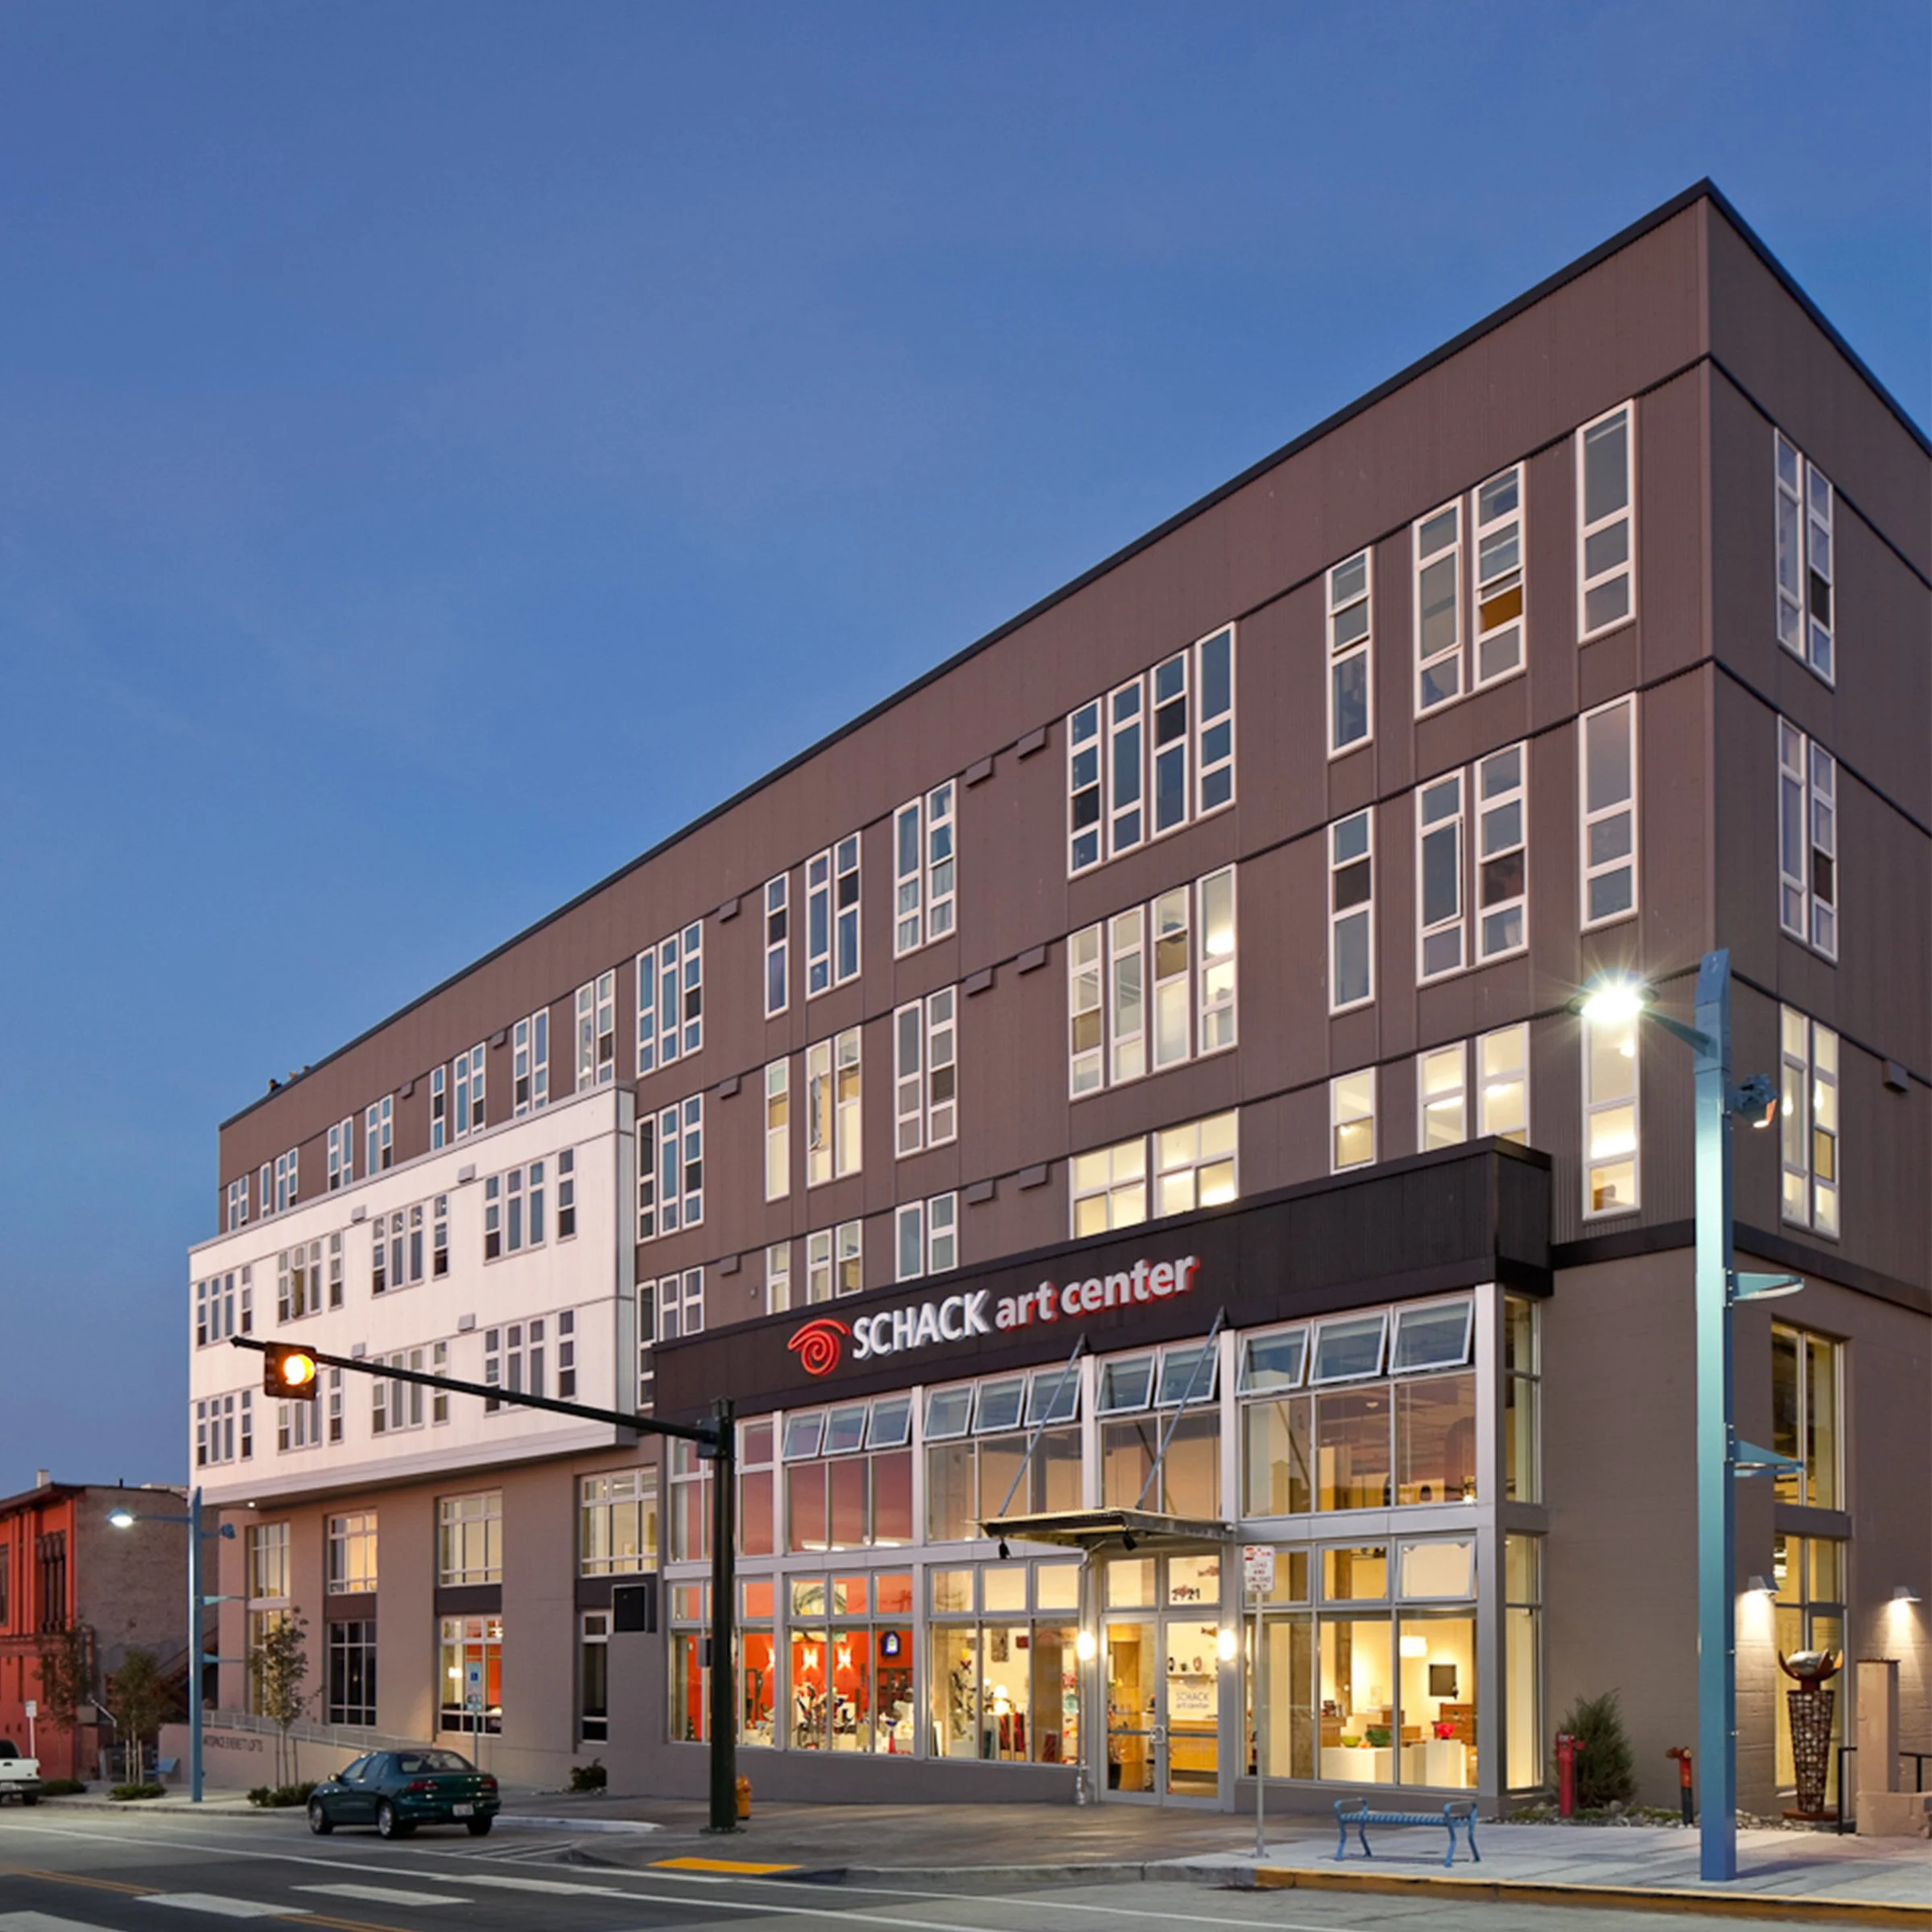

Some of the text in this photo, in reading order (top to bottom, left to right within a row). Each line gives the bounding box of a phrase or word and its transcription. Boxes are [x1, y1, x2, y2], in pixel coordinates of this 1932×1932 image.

[852, 1255, 1200, 1360] SCHACK art center
